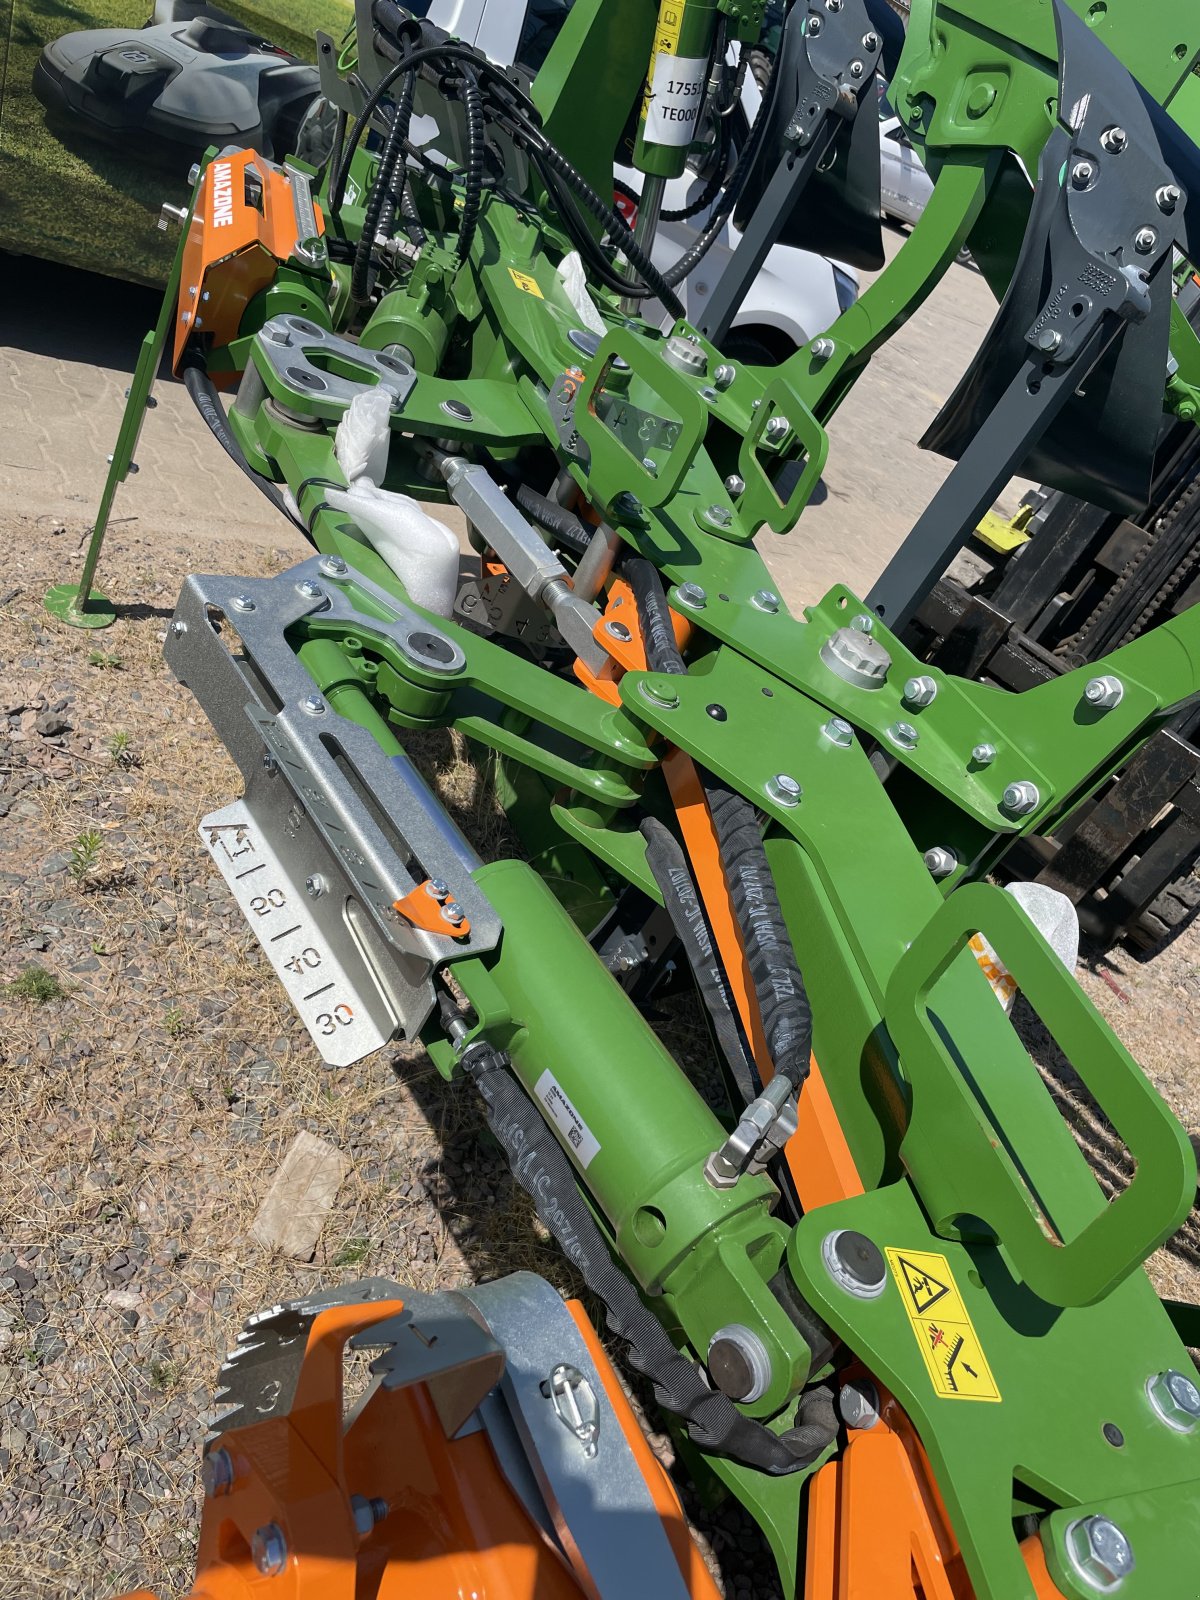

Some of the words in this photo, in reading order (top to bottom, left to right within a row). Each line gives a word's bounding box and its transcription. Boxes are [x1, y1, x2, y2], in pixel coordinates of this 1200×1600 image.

[213, 162, 233, 228] AMAZONE
[249, 888, 287, 917] 50
[668, 867, 702, 923] IC-207/07
[740, 865, 768, 918] IC-207/07
[692, 919, 712, 957] MSHA
[284, 947, 322, 975] 40
[315, 1003, 354, 1036] 30
[551, 1085, 583, 1131] AMAZONE
